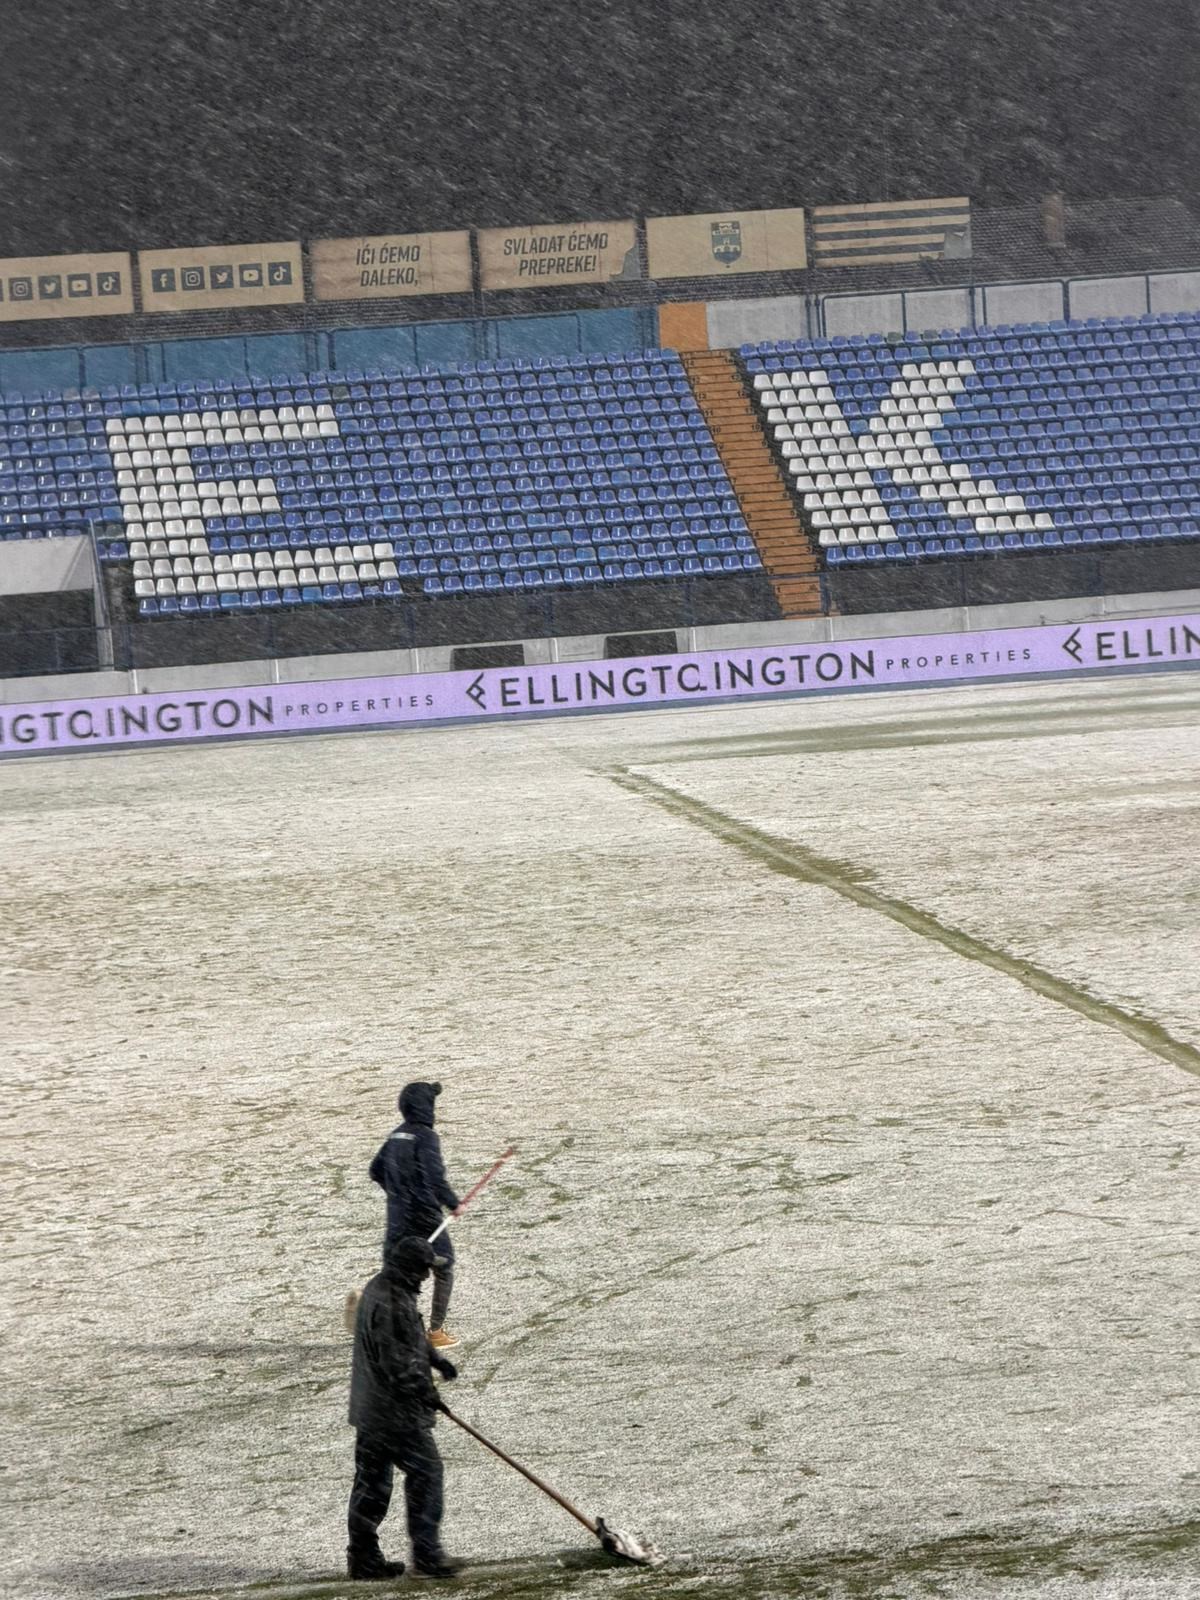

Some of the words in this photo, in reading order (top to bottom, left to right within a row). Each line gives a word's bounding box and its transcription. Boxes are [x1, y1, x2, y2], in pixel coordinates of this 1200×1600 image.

[356, 243, 377, 266] IĆI
[379, 238, 421, 264] ĆEMO
[503, 234, 564, 256] SVLADAT
[567, 229, 609, 251] ĆEMO
[519, 255, 597, 277] PREPREKE!
[360, 268, 419, 287] DALEKO,
[886, 648, 1032, 670] PROPERTIES
[286, 694, 434, 716] PROPERTIES
